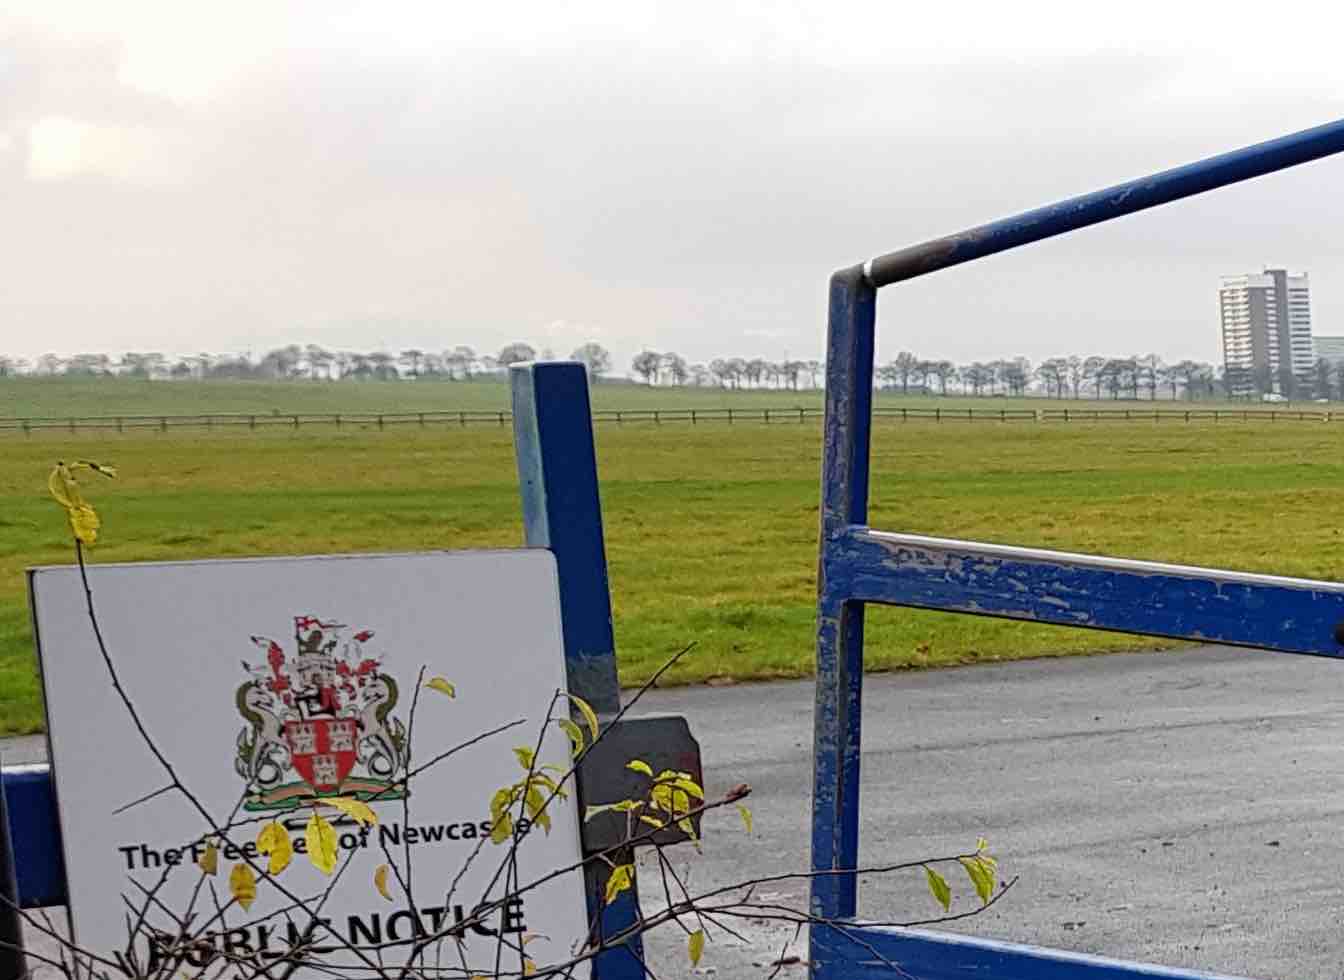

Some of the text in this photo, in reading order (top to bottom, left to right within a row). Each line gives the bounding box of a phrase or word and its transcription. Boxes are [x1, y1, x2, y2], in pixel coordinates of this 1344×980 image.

[119, 844, 183, 870] The
[379, 817, 531, 847] Newcase
[347, 899, 527, 946] NOTICE
